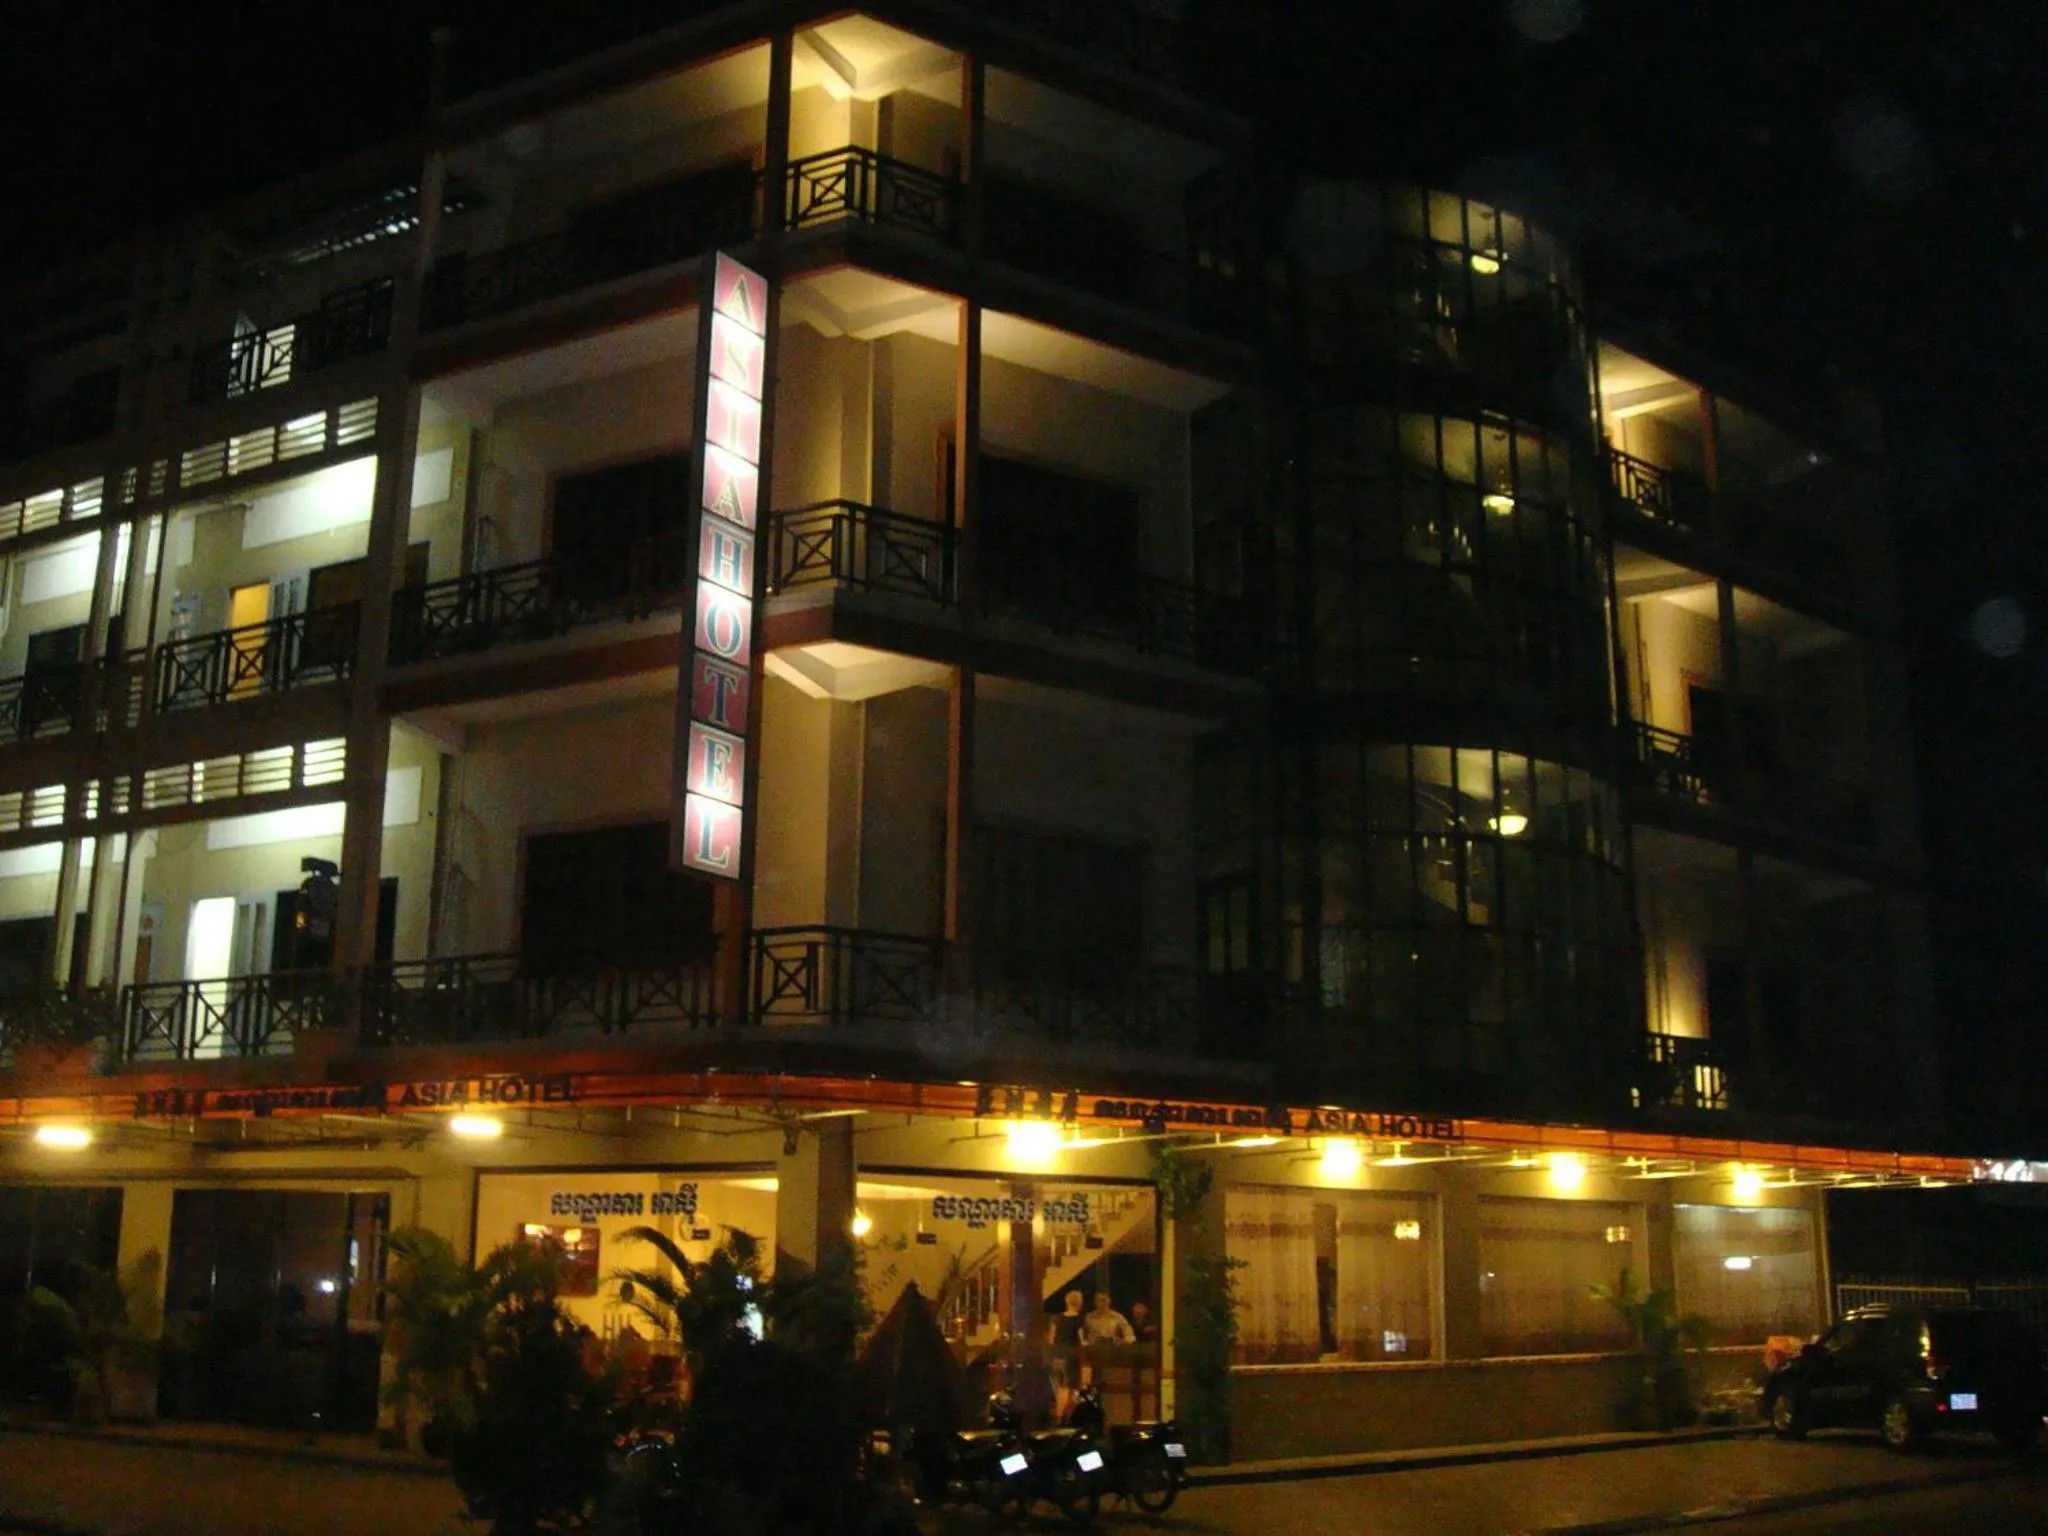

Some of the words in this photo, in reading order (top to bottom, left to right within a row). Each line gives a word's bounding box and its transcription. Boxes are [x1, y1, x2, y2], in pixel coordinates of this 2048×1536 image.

[711, 272, 758, 524] ASIA
[697, 528, 747, 868] HOTEL
[399, 1079, 467, 1105] ASIA
[479, 1073, 579, 1103] HOTEL
[1305, 1108, 1373, 1134] ASIA
[1379, 1111, 1460, 1140] HOTEL
